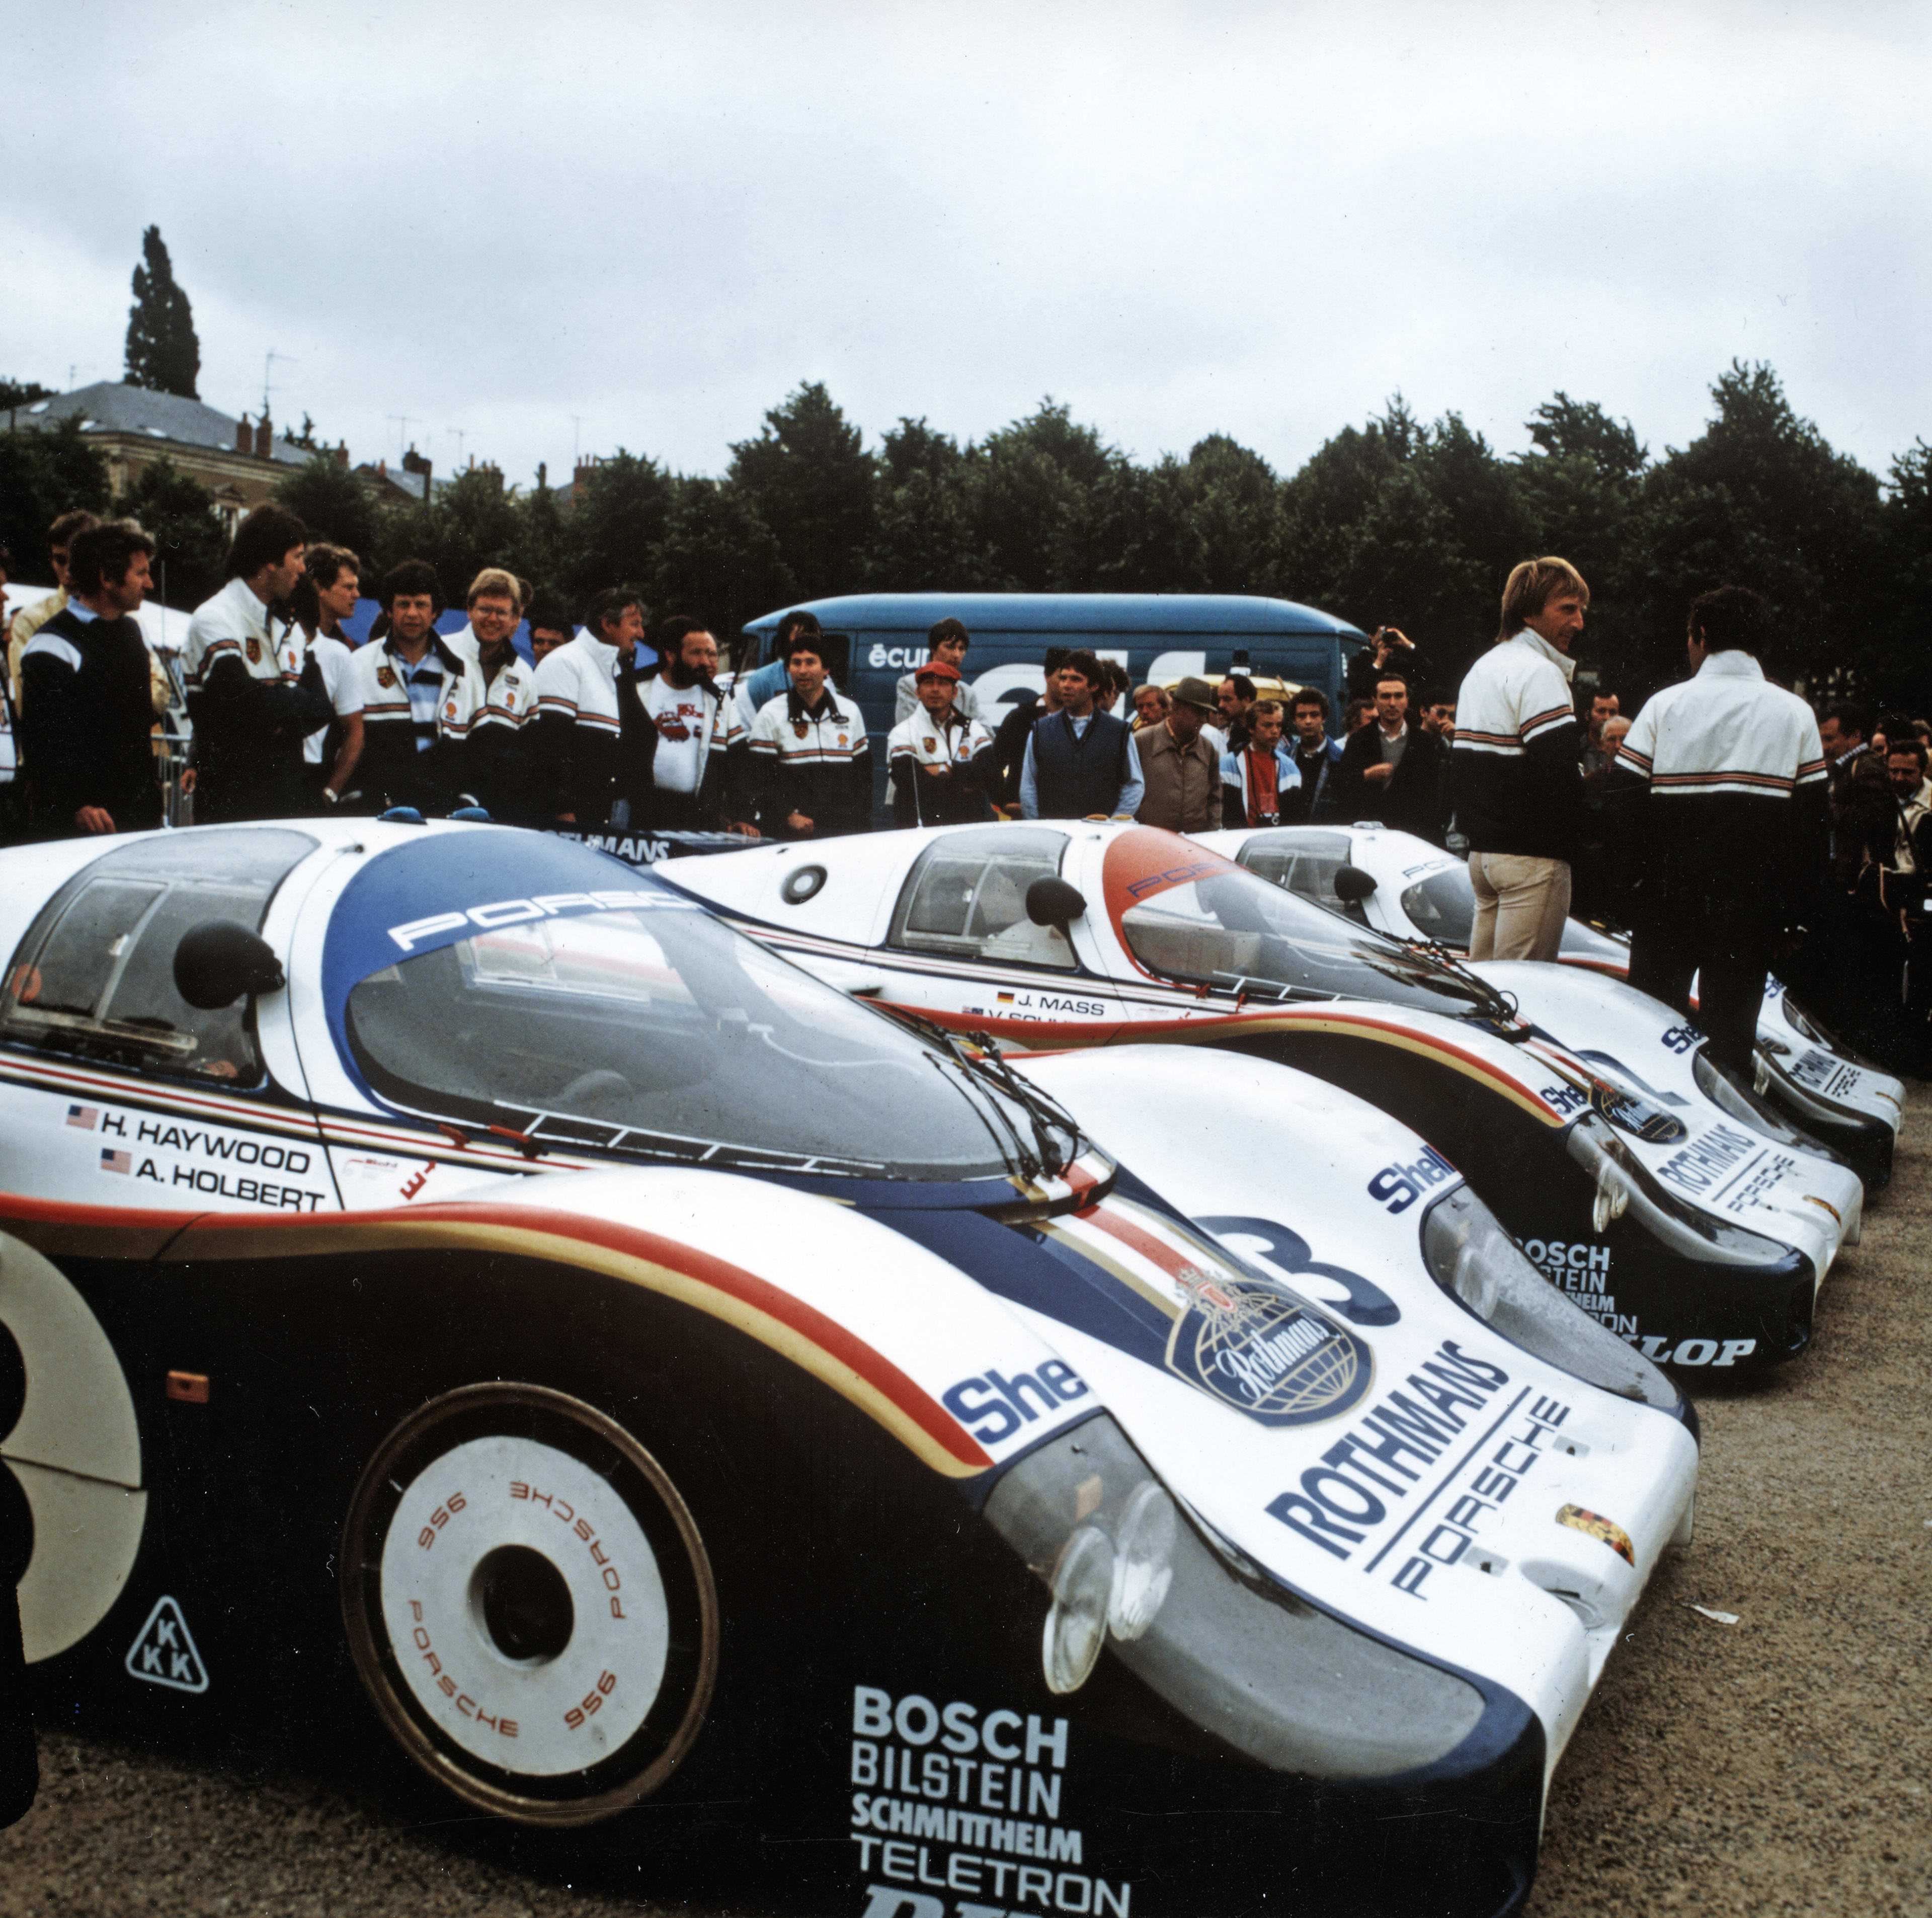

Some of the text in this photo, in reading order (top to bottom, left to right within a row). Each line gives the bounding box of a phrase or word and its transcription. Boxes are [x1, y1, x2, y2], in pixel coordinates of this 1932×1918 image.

[388, 891, 701, 951] PORSC
[1018, 994, 1105, 1016] J. MASS
[102, 1112, 312, 1175] H. HAYWOOD
[1367, 1145, 1457, 1214] Shell
[1657, 1123, 1756, 1195] ROTHMANS
[136, 1159, 325, 1212] A. HOLBERT
[1190, 1215, 1401, 1326] 3
[1515, 1237, 1610, 1271] OSCH
[1566, 1291, 1615, 1313] HELM
[1215, 1316, 1343, 1401] Rothmans
[1264, 1340, 1509, 1561] ROTHMANS
[417, 1492, 467, 1550] 956
[1391, 1395, 1571, 1602] PORSCHE
[509, 1480, 626, 1619] PORSCHE
[408, 1600, 519, 1738] PORSCHE
[564, 1669, 618, 1731] 956
[853, 1685, 1069, 1769] BOSCH
[851, 1740, 1062, 1820] BILSTEIN
[851, 1792, 1083, 1865] SCHMITTHELM
[850, 1832, 1131, 1918] TELETRON
